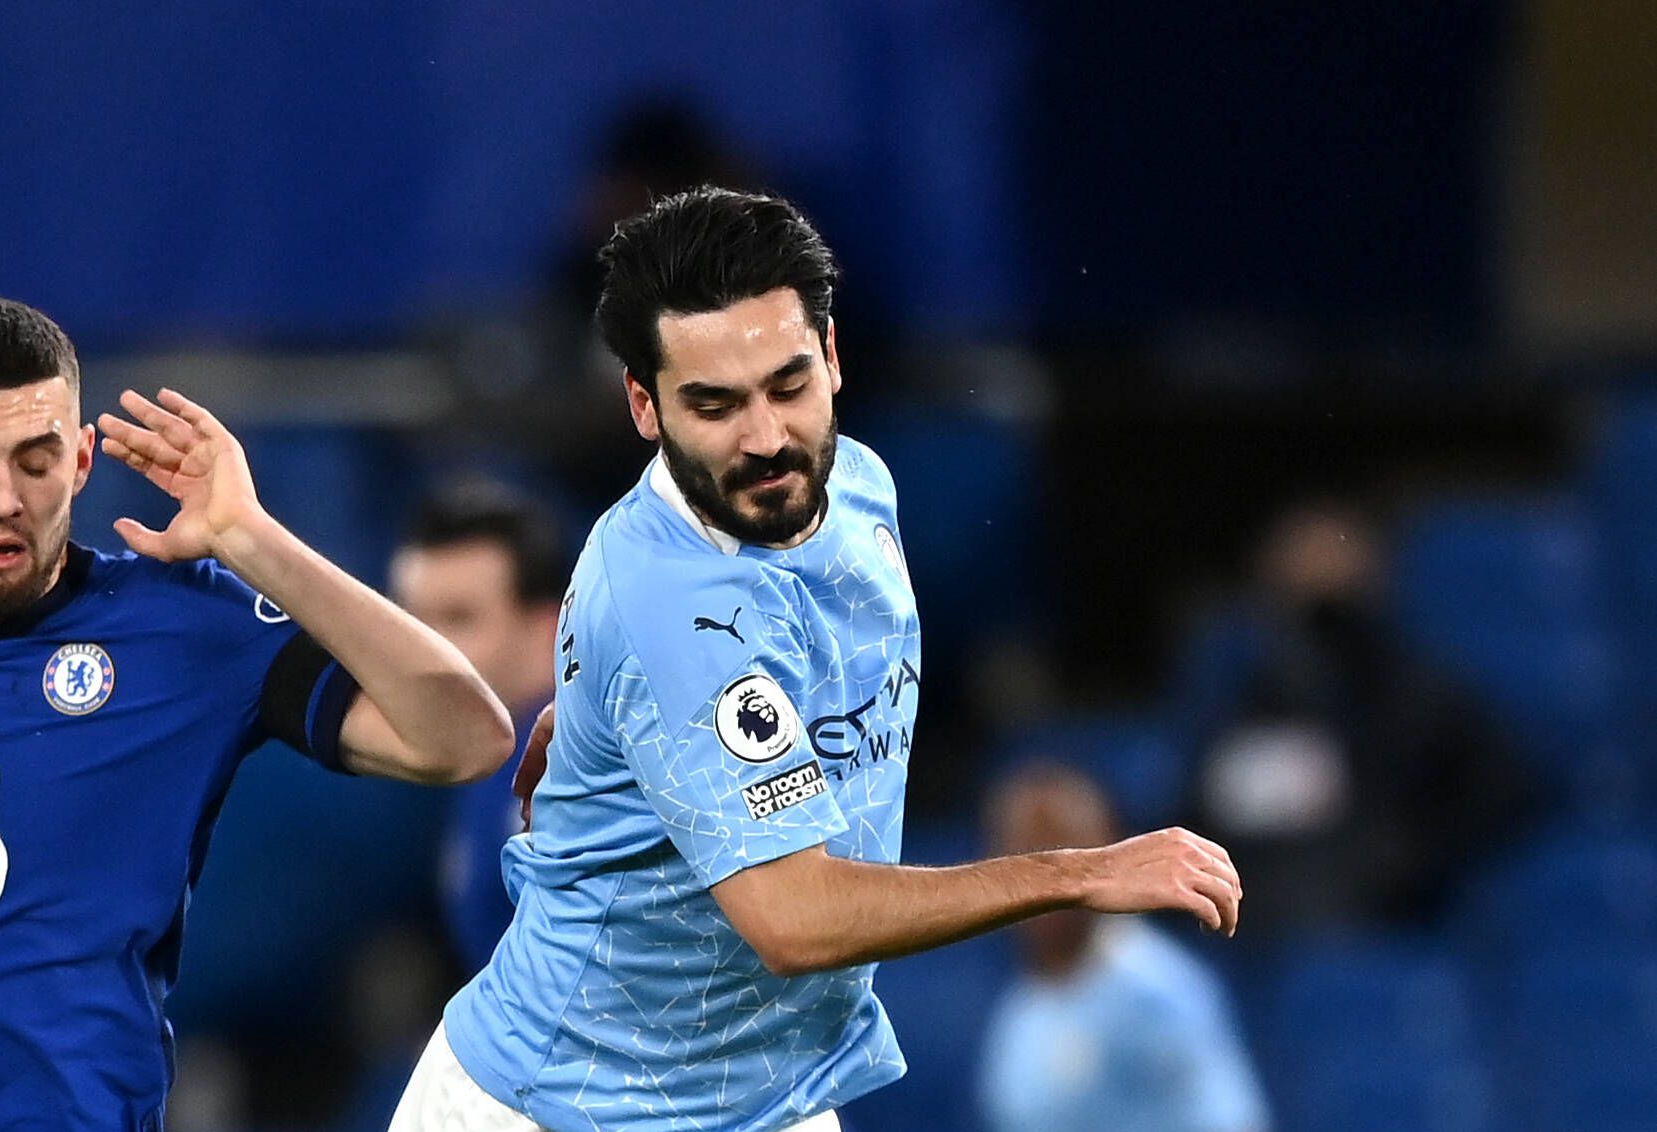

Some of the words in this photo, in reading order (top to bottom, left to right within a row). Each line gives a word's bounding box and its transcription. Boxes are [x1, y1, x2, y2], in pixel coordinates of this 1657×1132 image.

[57, 644, 103, 661] CHELSEA
[742, 785, 770, 804] No
[770, 765, 818, 796] room
[747, 799, 774, 820] for
[775, 777, 827, 810] racism
